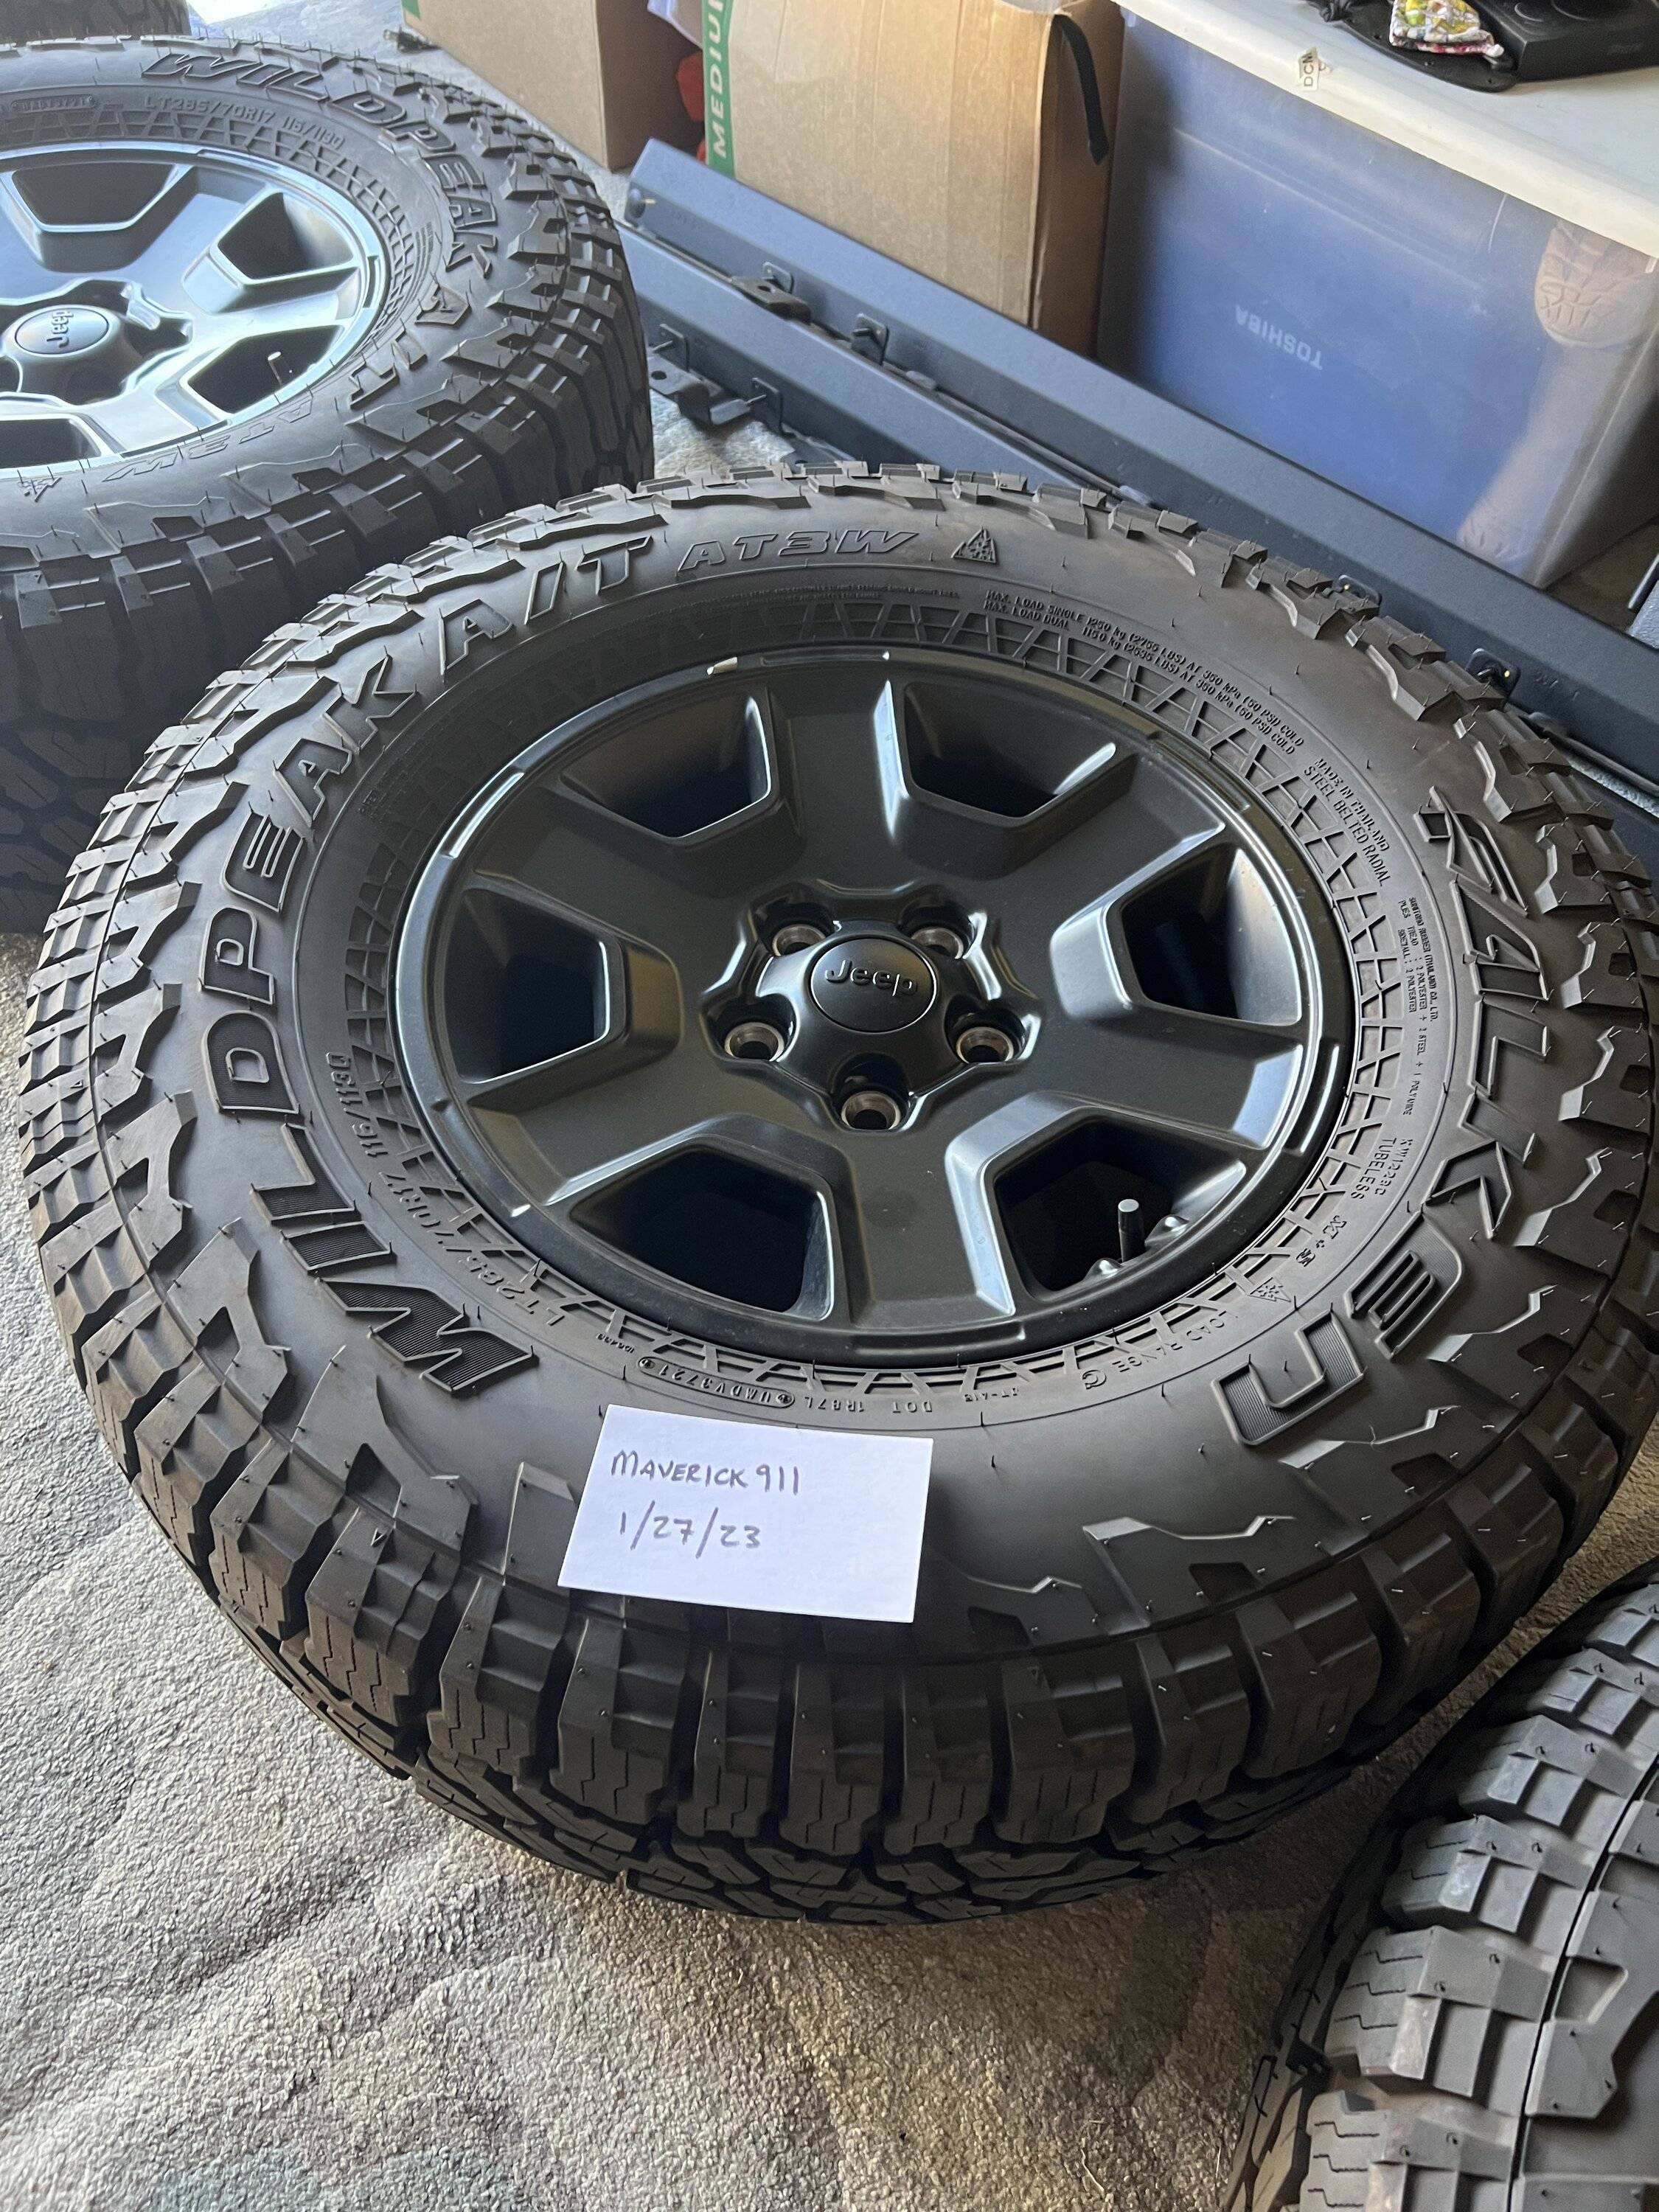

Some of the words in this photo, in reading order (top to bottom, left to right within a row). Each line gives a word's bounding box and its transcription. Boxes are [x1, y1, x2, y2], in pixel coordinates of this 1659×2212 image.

[141, 52, 498, 279] WILDPEAK
[46, 310, 74, 349] Jeep
[1235, 305, 1324, 370] TOSHIBA
[677, 529, 919, 573] AT3W
[1009, 605, 1043, 622] LOAD
[1040, 613, 1074, 631] DUAL
[1192, 677, 1218, 695] 350
[1270, 731, 1298, 755] COLD
[1013, 595, 1046, 611] LOAD
[1046, 603, 1087, 624] SINGLE
[1199, 669, 1225, 687] 350
[1279, 723, 1305, 747] COLD
[1302, 765, 1335, 802] STEEL
[1332, 799, 1371, 845] BELTED
[1360, 844, 1393, 887] RADIAL
[1314, 758, 1344, 787] MADE
[1337, 785, 1356, 800] IN
[1351, 797, 1391, 852] THAILAND
[1397, 899, 1412, 919] PLIES
[824, 959, 918, 997] Jeep
[1405, 974, 1418, 1013] POLYESTER
[1416, 971, 1427, 1010] POLYESTER
[198, 654, 537, 1392] WILDPEAK
[1429, 1006, 1439, 1022] LTD.
[1416, 1034, 1427, 1057] STEEL
[1211, 785, 1549, 1445] FALKEN
[1349, 1135, 1399, 1203] TUBELESS
[1184, 1309, 1240, 1343] LOAD
[1113, 1340, 1184, 1374] RANGE
[891, 1399, 933, 1413] DOT
[619, 1500, 761, 1559] 1/27/23
